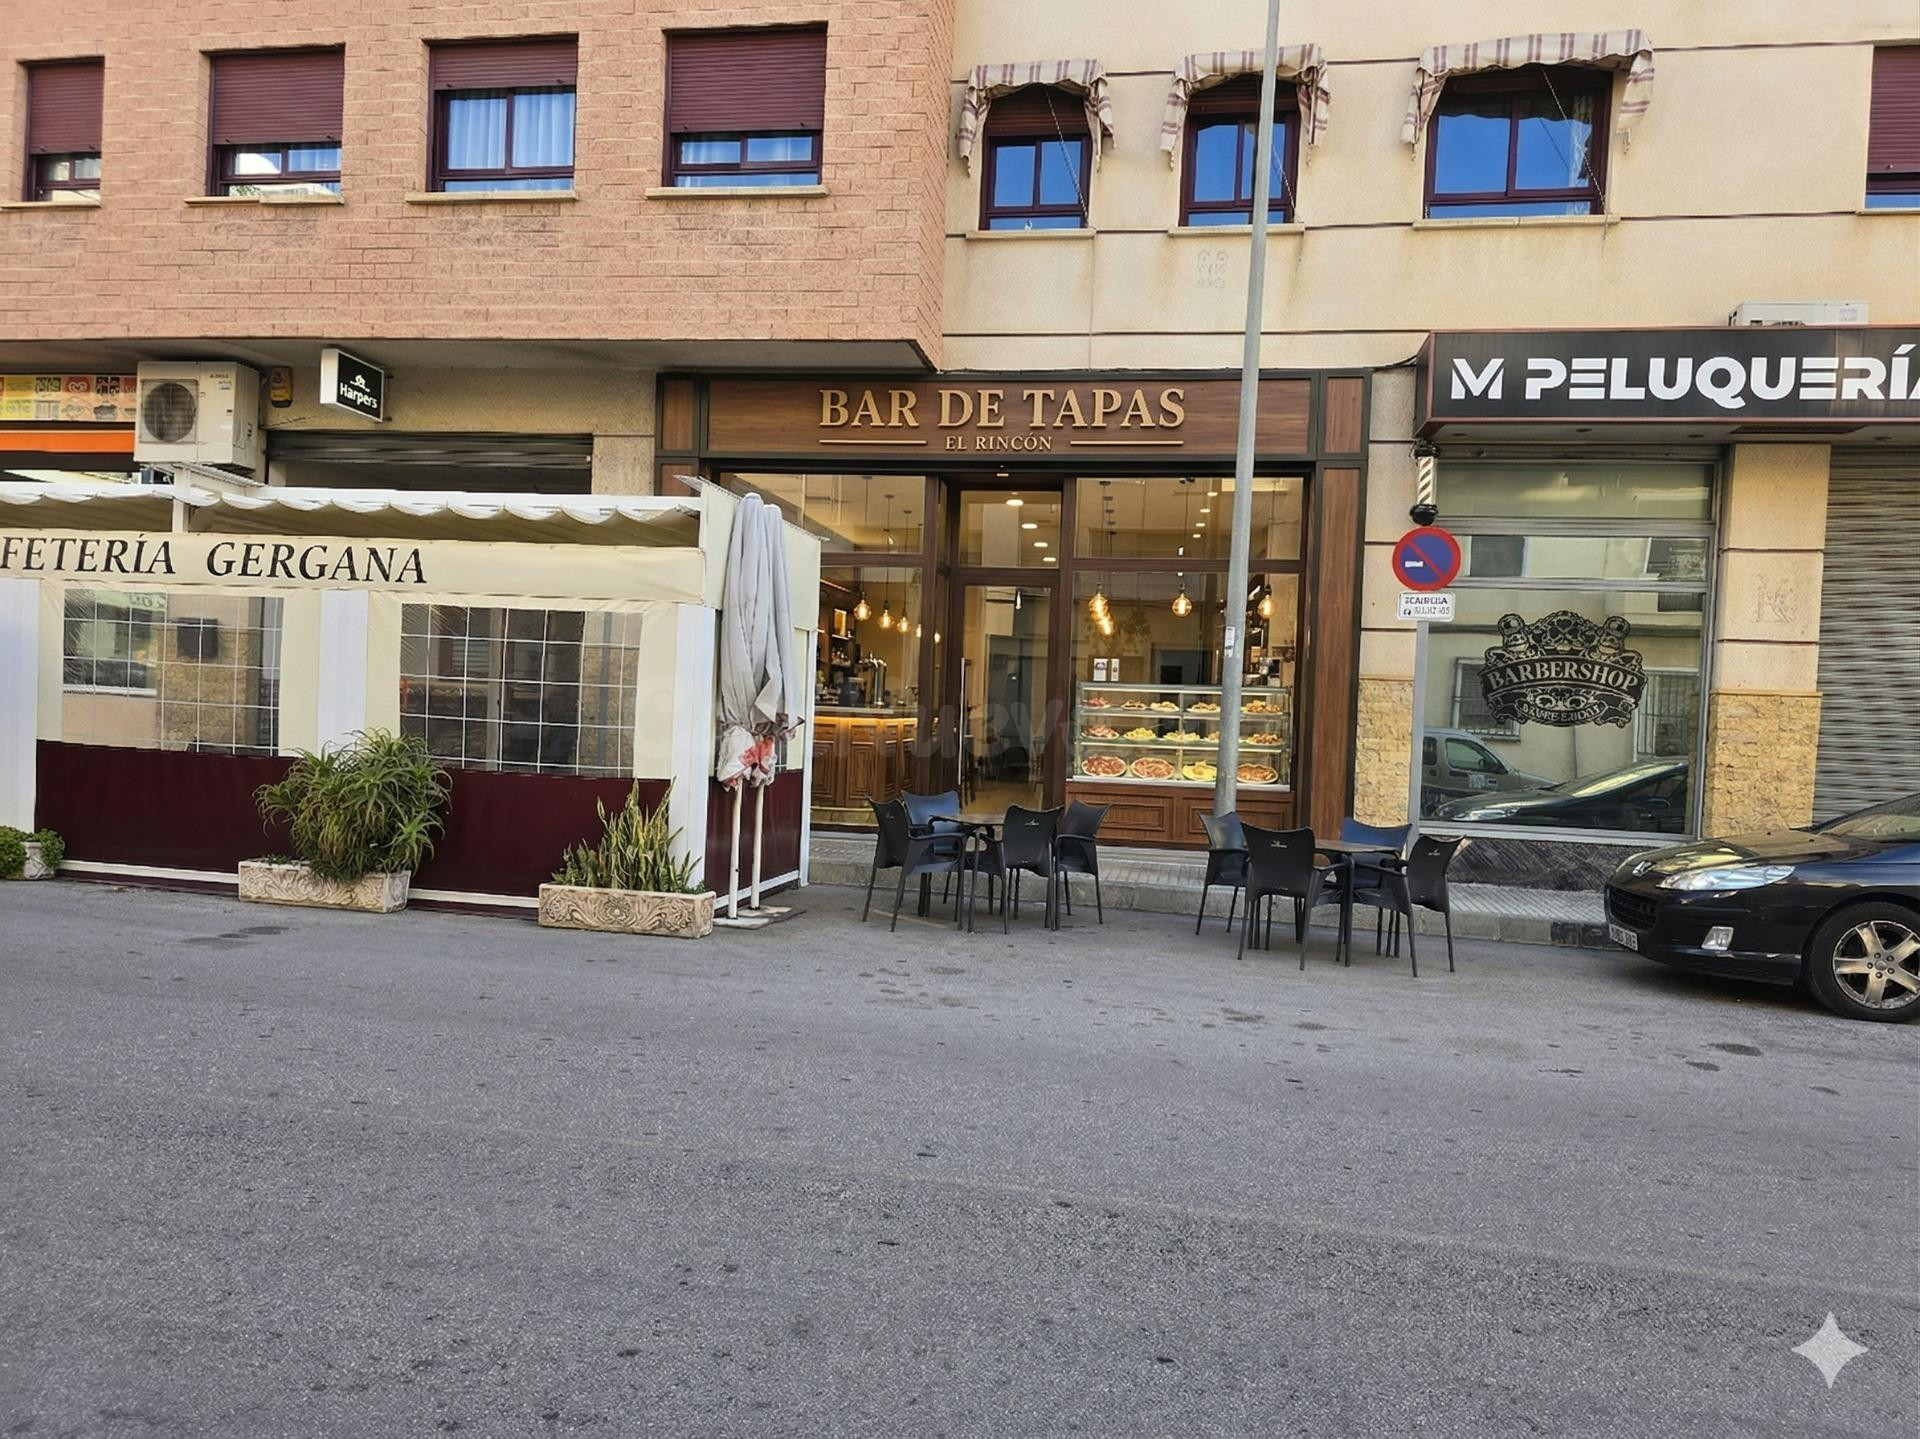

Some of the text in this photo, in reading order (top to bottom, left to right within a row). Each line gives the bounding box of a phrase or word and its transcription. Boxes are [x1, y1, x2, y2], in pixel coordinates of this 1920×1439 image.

[1525, 343, 1920, 410] PELUQUERÍ
[340, 382, 378, 409] Harpers
[819, 388, 1185, 429] BAR DE TAPAS
[945, 433, 1052, 451] EL RINCÓN
[0, 533, 428, 585] FETERÍA GERGANA
[1486, 661, 1639, 691] BARBERSHOP
